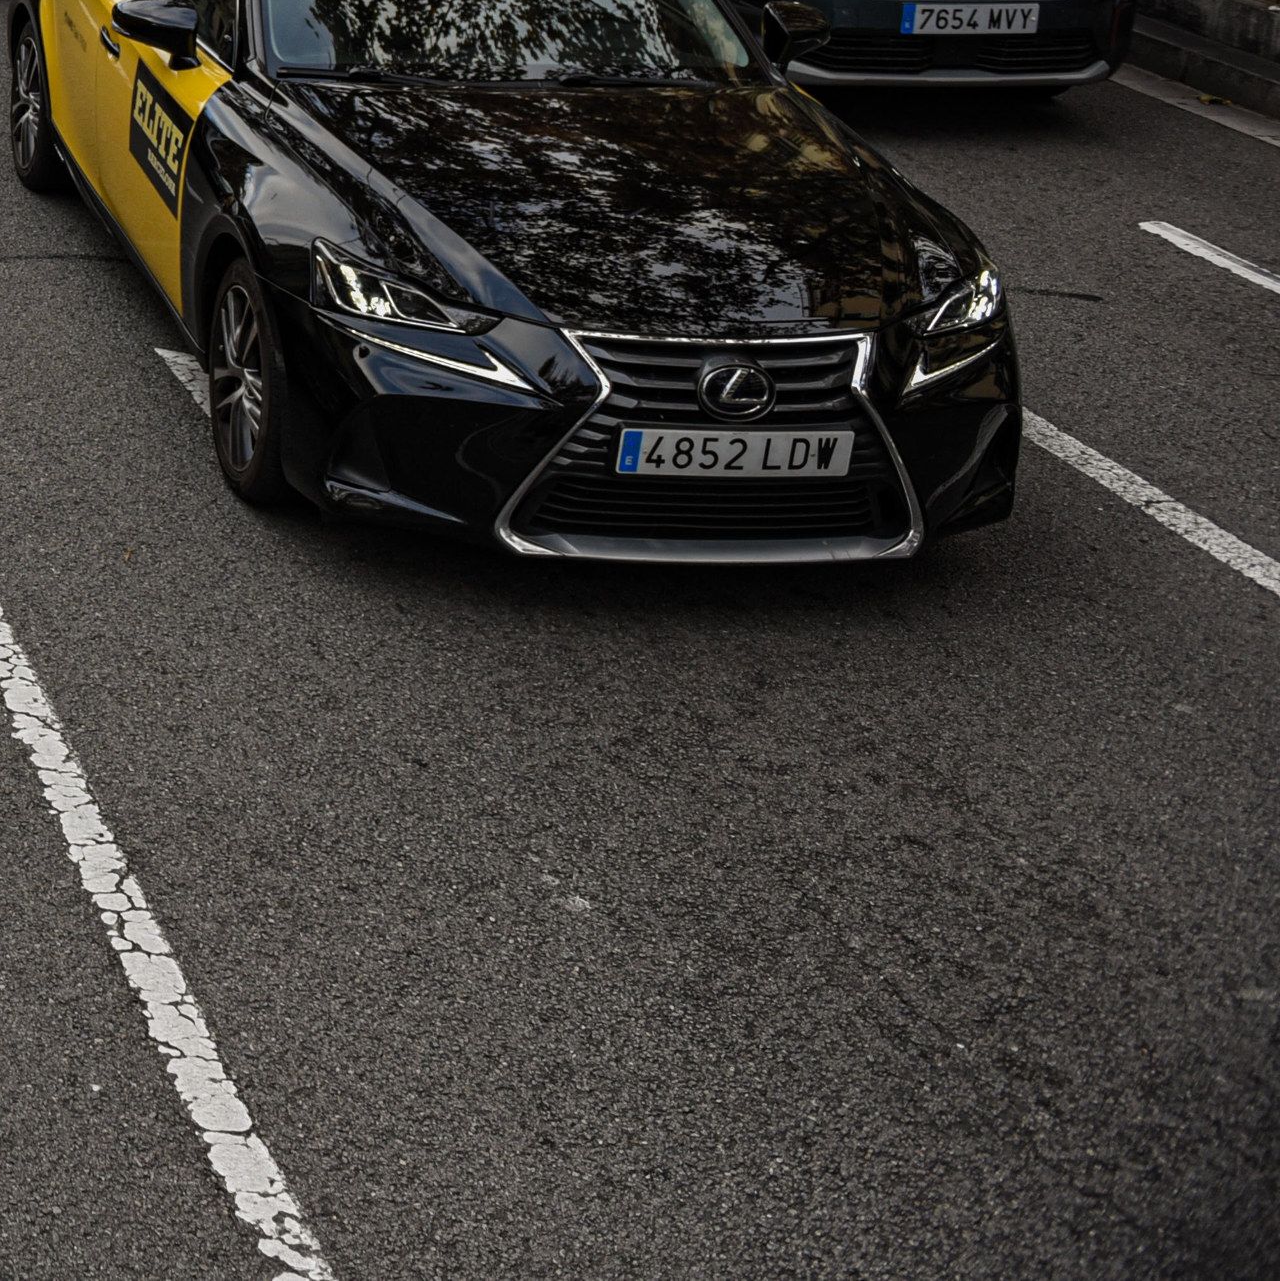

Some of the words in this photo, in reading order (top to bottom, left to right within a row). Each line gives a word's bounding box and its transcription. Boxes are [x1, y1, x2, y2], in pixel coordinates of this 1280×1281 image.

[919, 9, 979, 30] 7654
[987, 8, 1033, 30] MVY
[133, 78, 185, 176] ELITE
[645, 436, 748, 470] 4852
[761, 437, 839, 470] LDW
